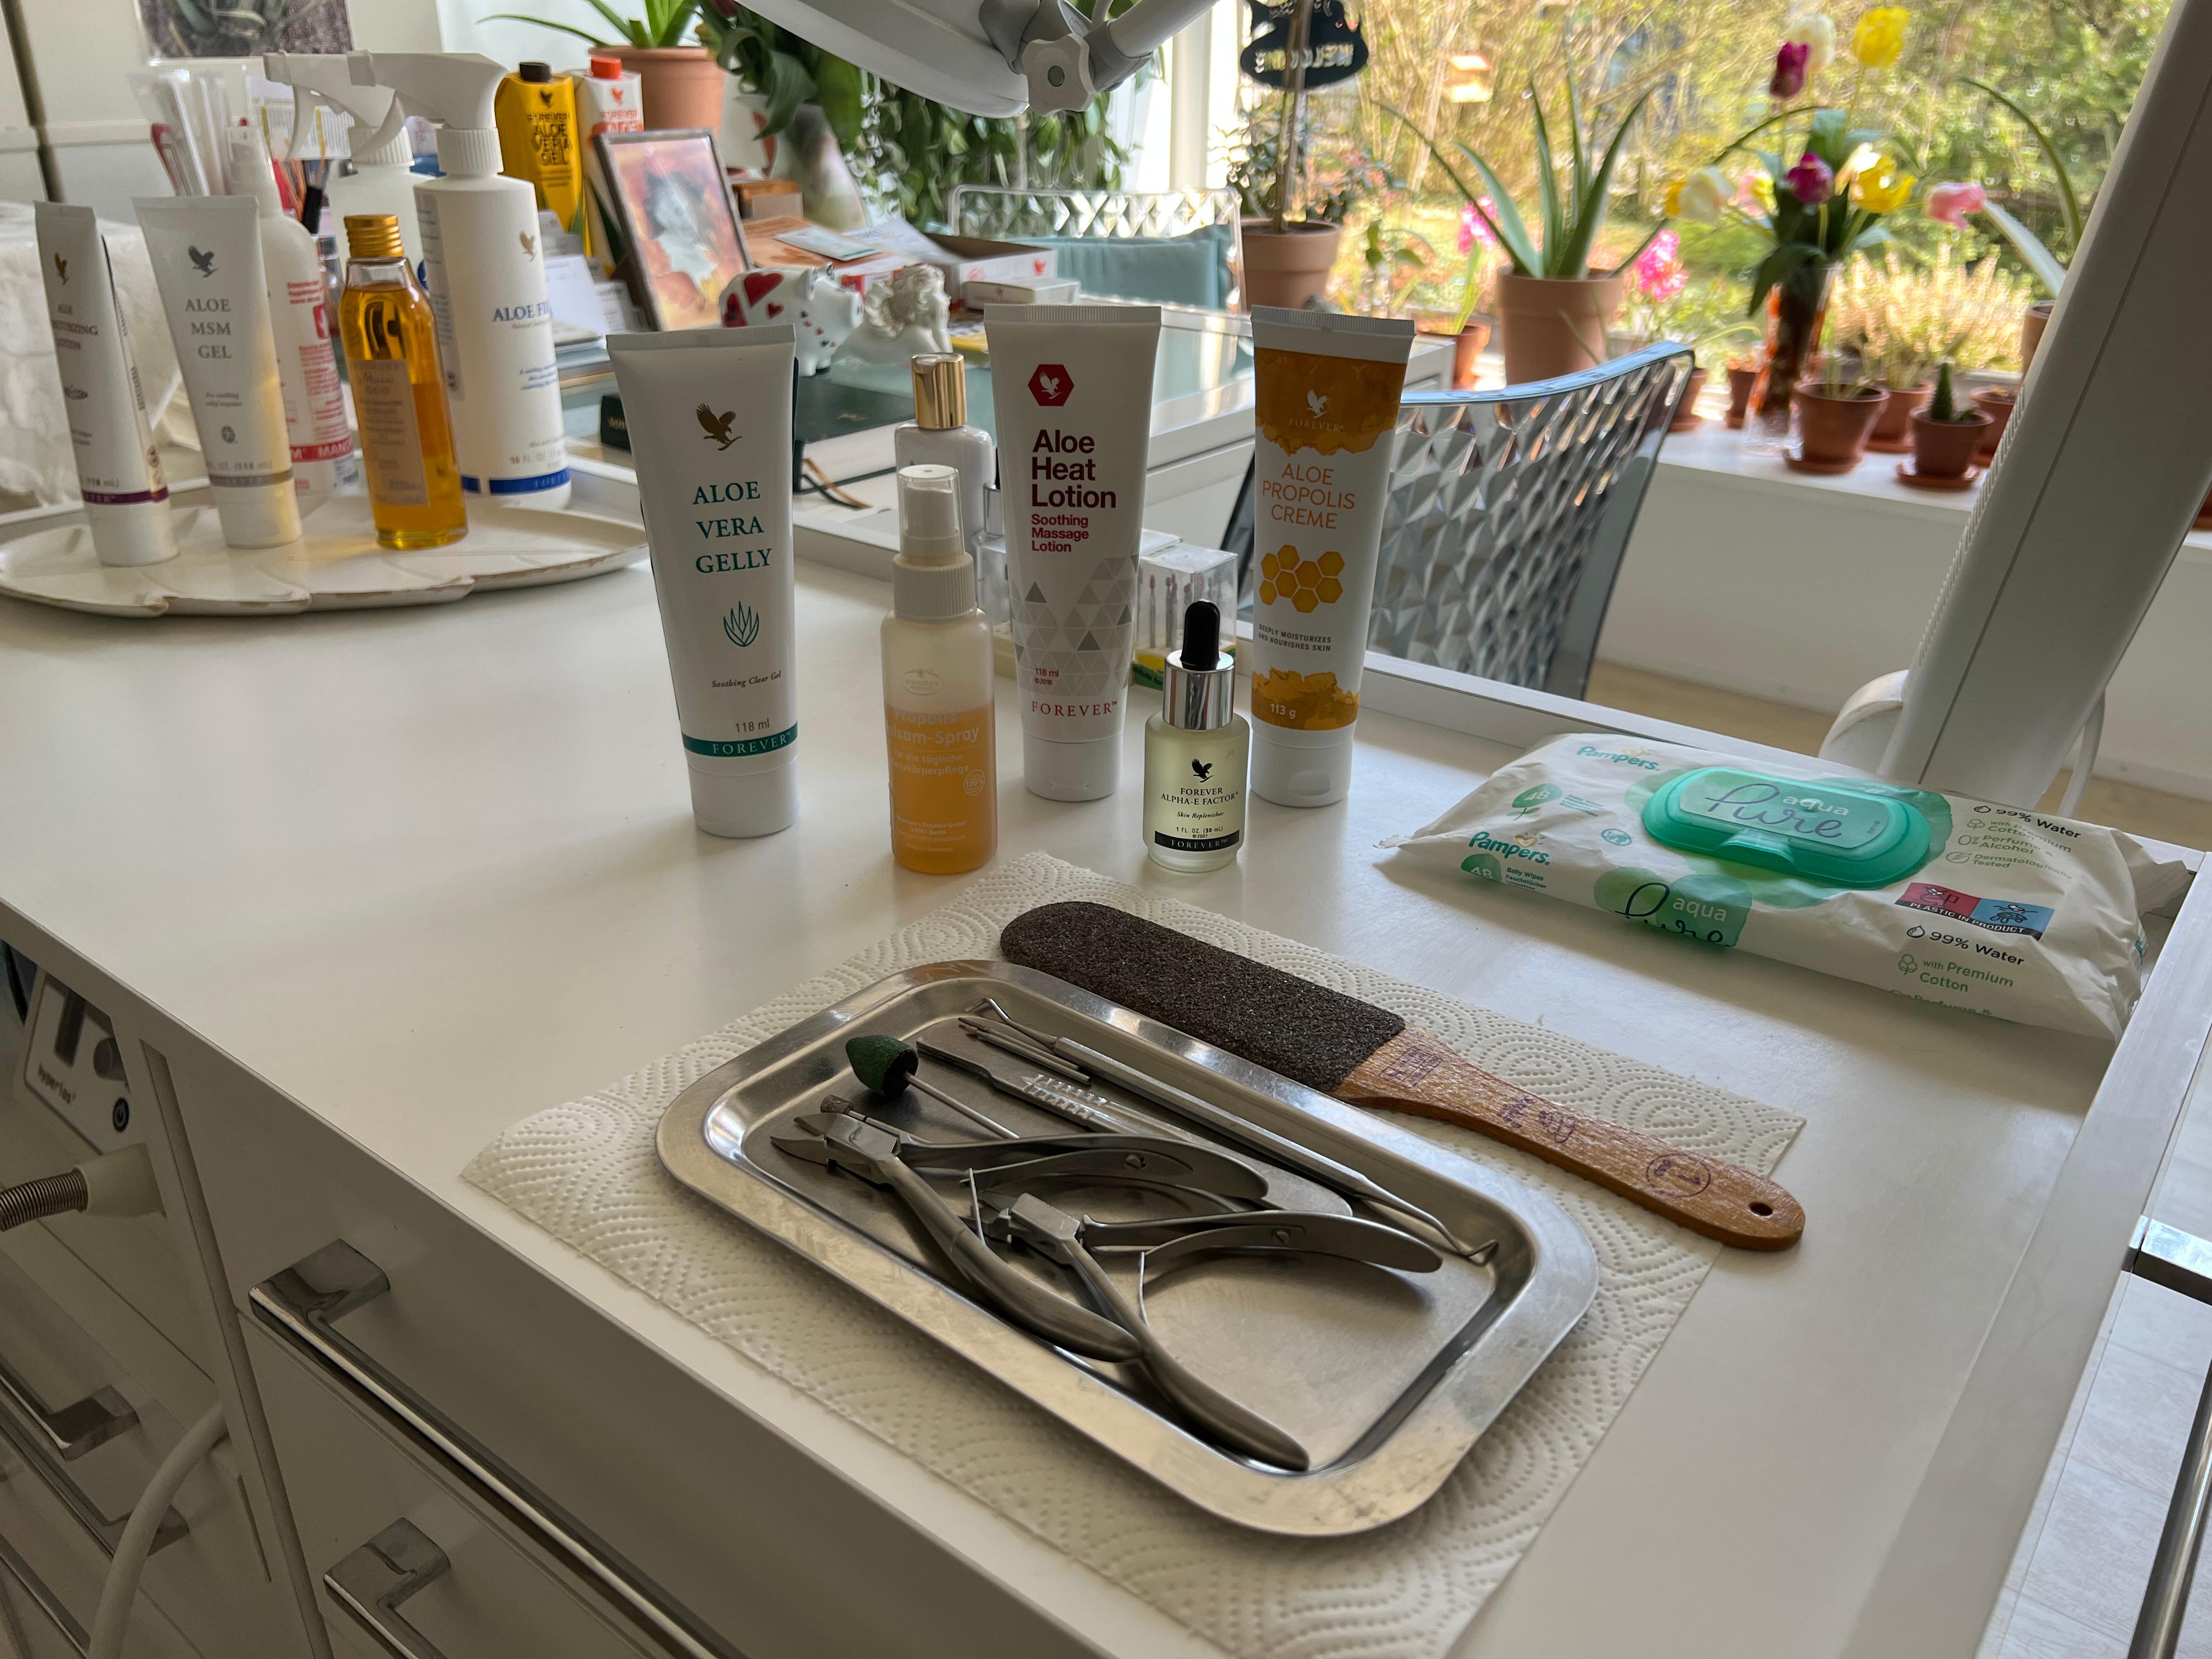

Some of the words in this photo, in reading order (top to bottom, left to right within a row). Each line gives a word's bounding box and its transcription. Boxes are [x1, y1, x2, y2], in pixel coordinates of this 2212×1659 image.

[185, 298, 231, 313] ALOE
[492, 304, 535, 322] ALOE
[191, 322, 231, 336] MSM
[198, 345, 232, 359] GEL
[1032, 430, 1095, 454] Aloe
[1031, 457, 1096, 481] Heat
[1282, 462, 1334, 486] ALOE
[693, 481, 760, 505] ALOE
[1031, 484, 1116, 509] Lotion
[1262, 480, 1356, 510] PROPOLIS
[1031, 514, 1088, 528] Soothing
[1271, 504, 1338, 529] CREME
[696, 516, 764, 539] VERA
[1031, 527, 1089, 541] Massage
[1031, 541, 1071, 552] Lotion
[696, 548, 772, 573] GELLY
[1259, 624, 1279, 636] DEEPLY
[1281, 631, 1331, 643] MOISTURIZES
[1259, 633, 1268, 641] AND
[1269, 637, 1310, 650] NOURISHES
[712, 679, 746, 688] Soothing
[749, 676, 769, 685] Clear
[771, 670, 782, 680] Gel
[1035, 668, 1047, 676] 118
[1049, 669, 1059, 678] ml
[895, 707, 958, 728] Propolis
[1270, 703, 1285, 715] 113
[1289, 709, 1296, 719] g
[735, 721, 755, 733] 118
[758, 718, 770, 730] ml
[1161, 793, 1200, 805] ALPHA-E
[1181, 787, 1223, 796] FOREVER
[1524, 789, 1550, 802] 48
[1705, 783, 1843, 839] Pure
[1782, 795, 1849, 816] aqua
[1192, 811, 1224, 820] Replenisher
[1995, 809, 2032, 822] 99%
[2037, 819, 2081, 838] Water
[1988, 826, 2035, 840] Cotton
[1979, 842, 2034, 855] Alcohol
[1983, 835, 2041, 851] Perfume
[1973, 859, 2010, 868] Tested
[1974, 853, 2073, 879] Dermatologically
[1506, 867, 1523, 876] Baby
[1525, 871, 1544, 881] Wipes
[1506, 874, 1547, 889] Feuchttücher
[1672, 898, 1727, 922] aqua
[1909, 901, 1956, 918] PLASTIC
[1972, 919, 2026, 934] PRODUCT
[1929, 930, 1970, 950] 99%
[1975, 943, 2025, 967] Water
[1922, 958, 1944, 970] with
[1946, 961, 2014, 989] Premium
[1920, 972, 1969, 994] Cotton
